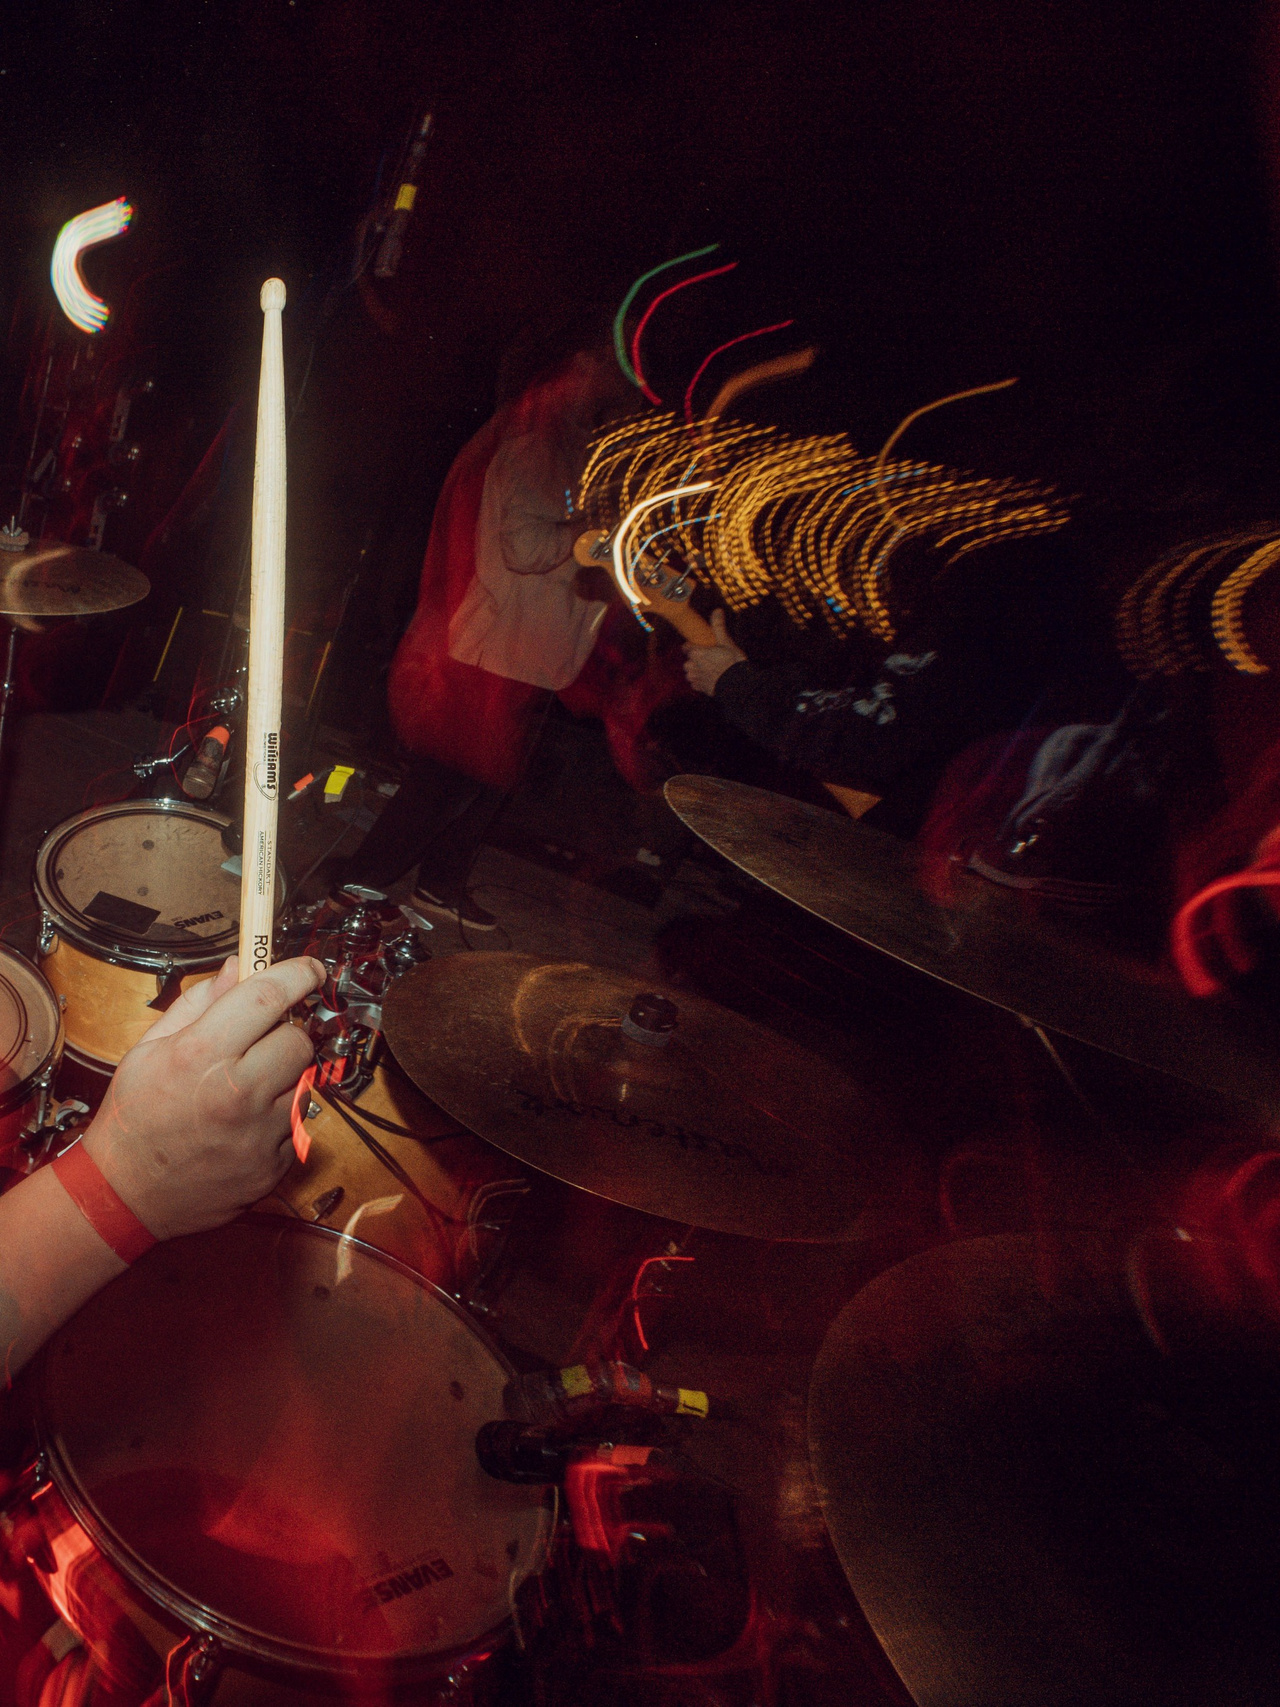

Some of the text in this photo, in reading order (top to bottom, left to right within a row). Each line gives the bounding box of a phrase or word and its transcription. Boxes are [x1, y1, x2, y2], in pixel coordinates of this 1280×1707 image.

[173, 910, 224, 930] EVANS
[253, 935, 269, 973] ROC
[373, 1558, 454, 1604] EVANS
